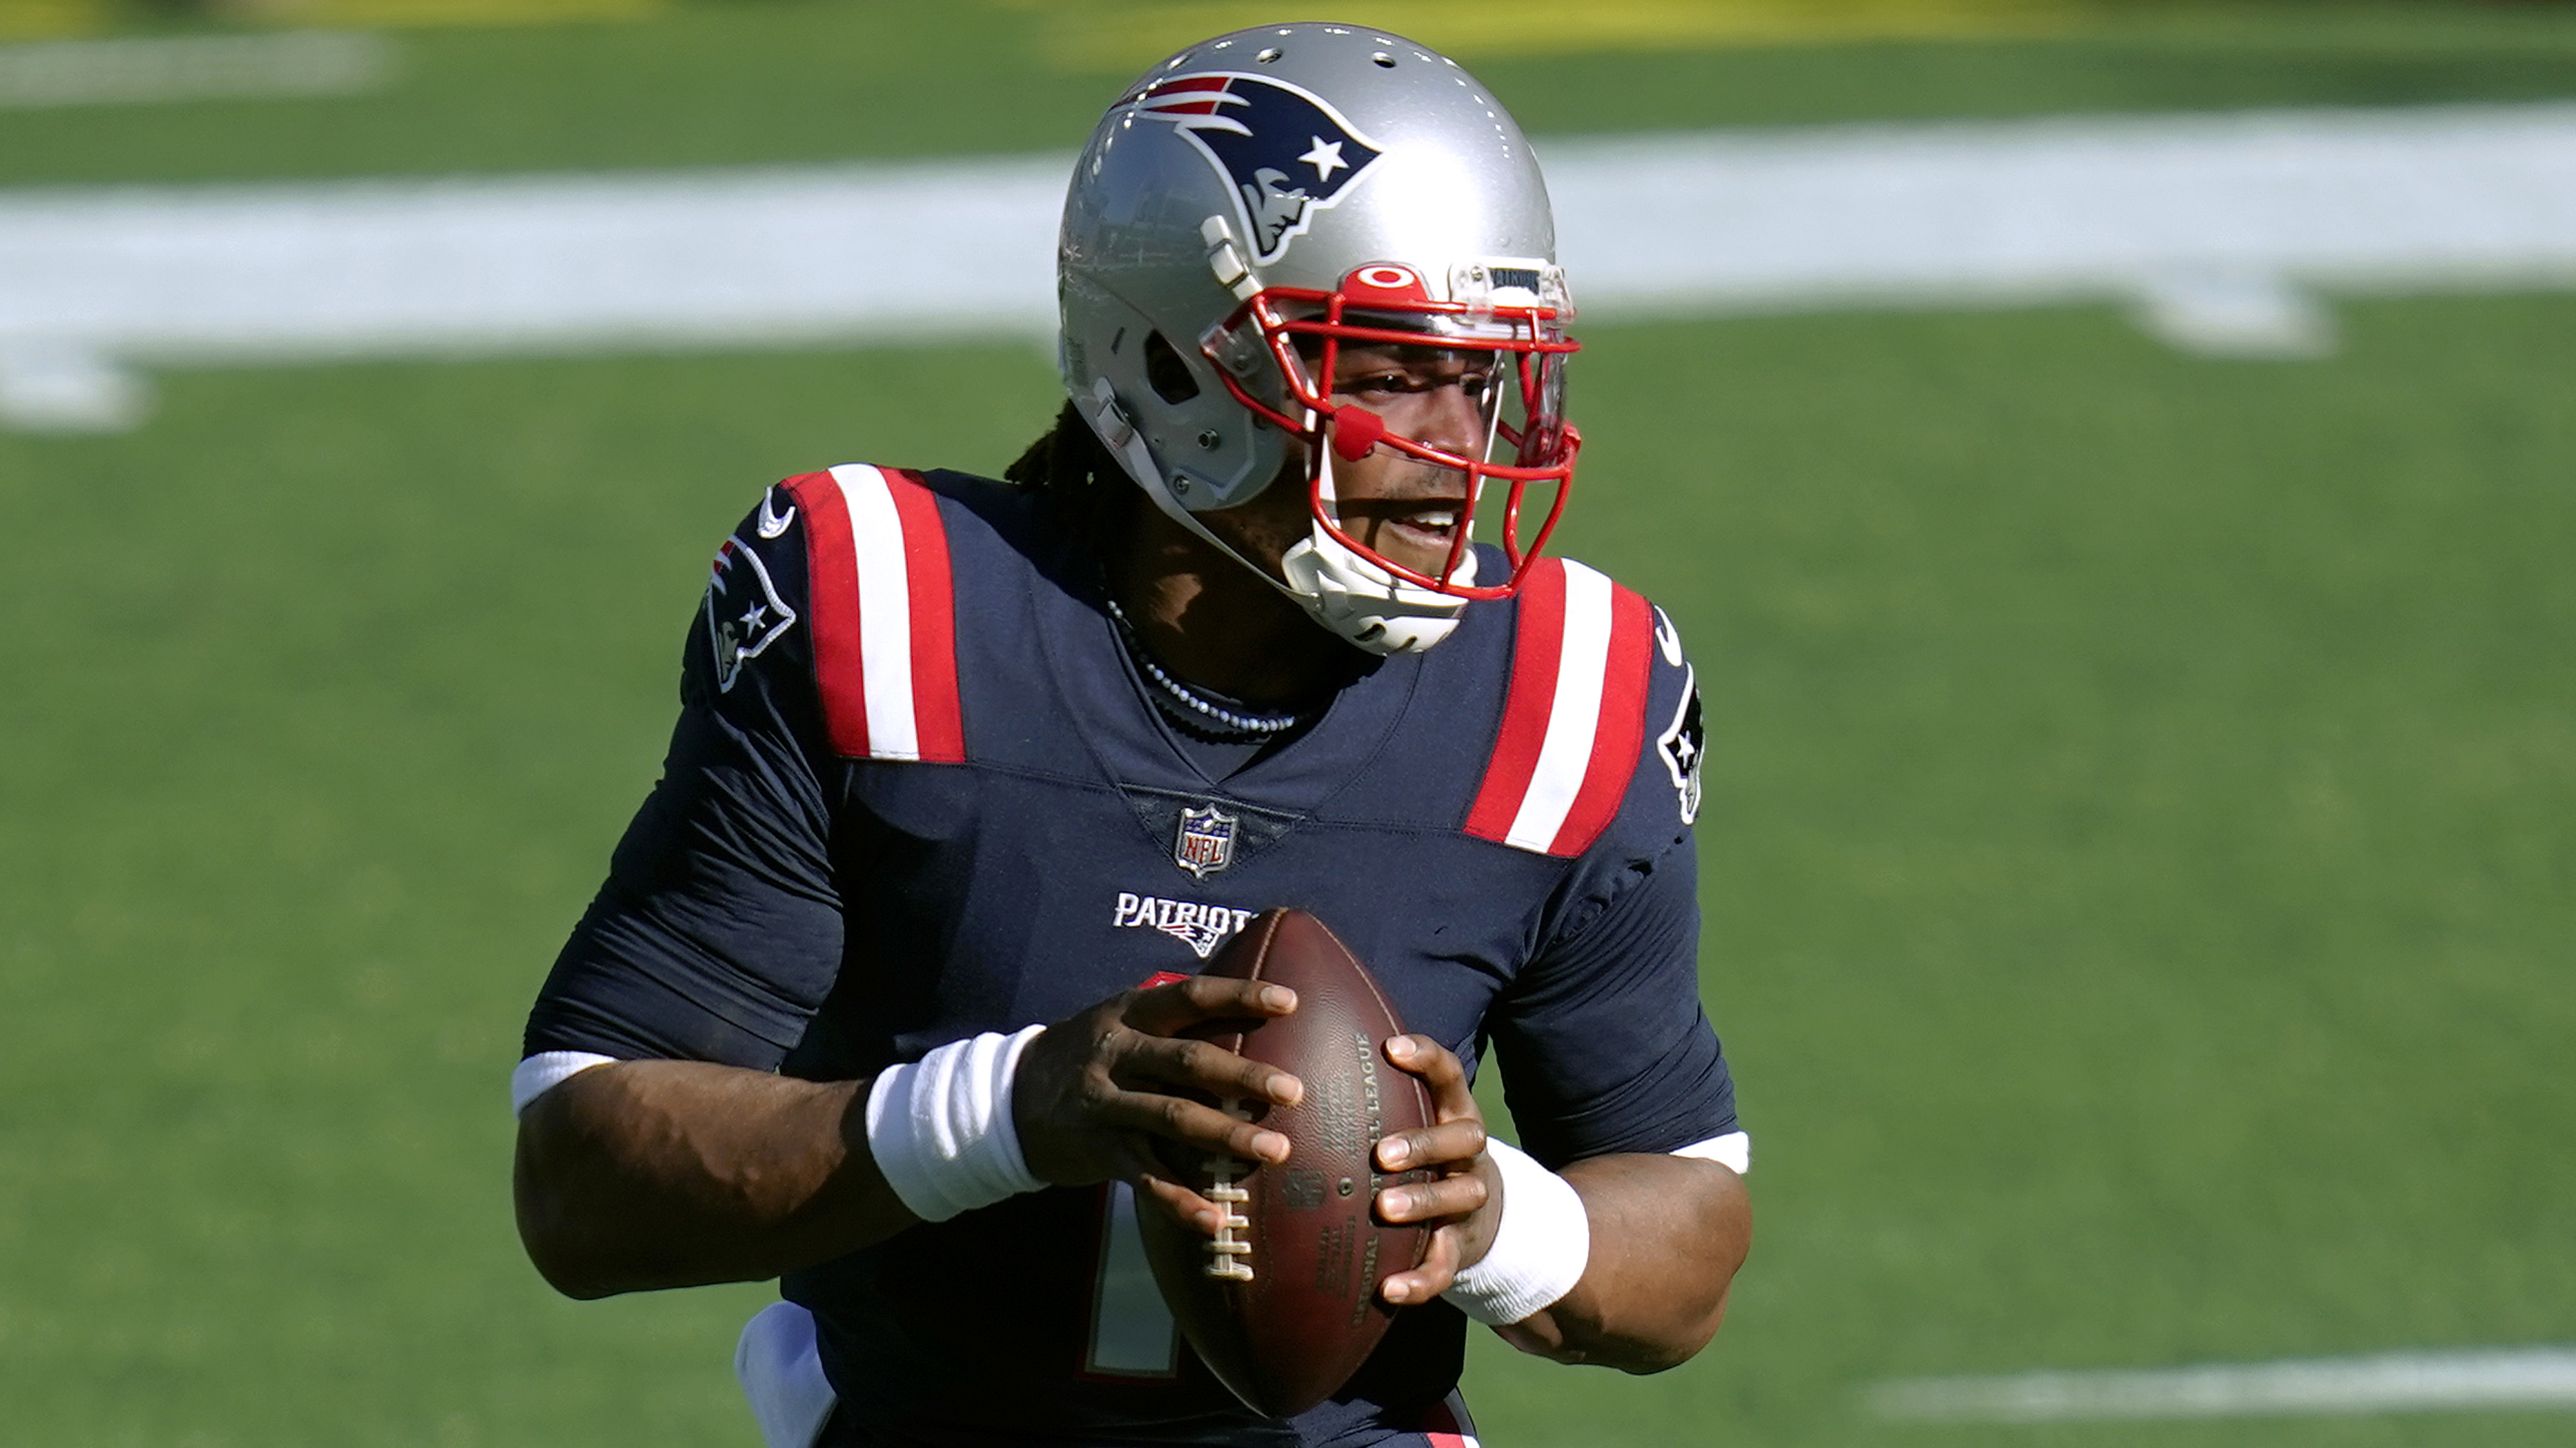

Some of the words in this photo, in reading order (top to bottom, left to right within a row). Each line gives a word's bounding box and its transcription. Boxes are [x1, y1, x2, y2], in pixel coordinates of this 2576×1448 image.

[1184, 835, 1223, 864] NFL
[1113, 892, 1260, 935] PATRIOT
[1355, 1032, 1381, 1113] LEAGUE
